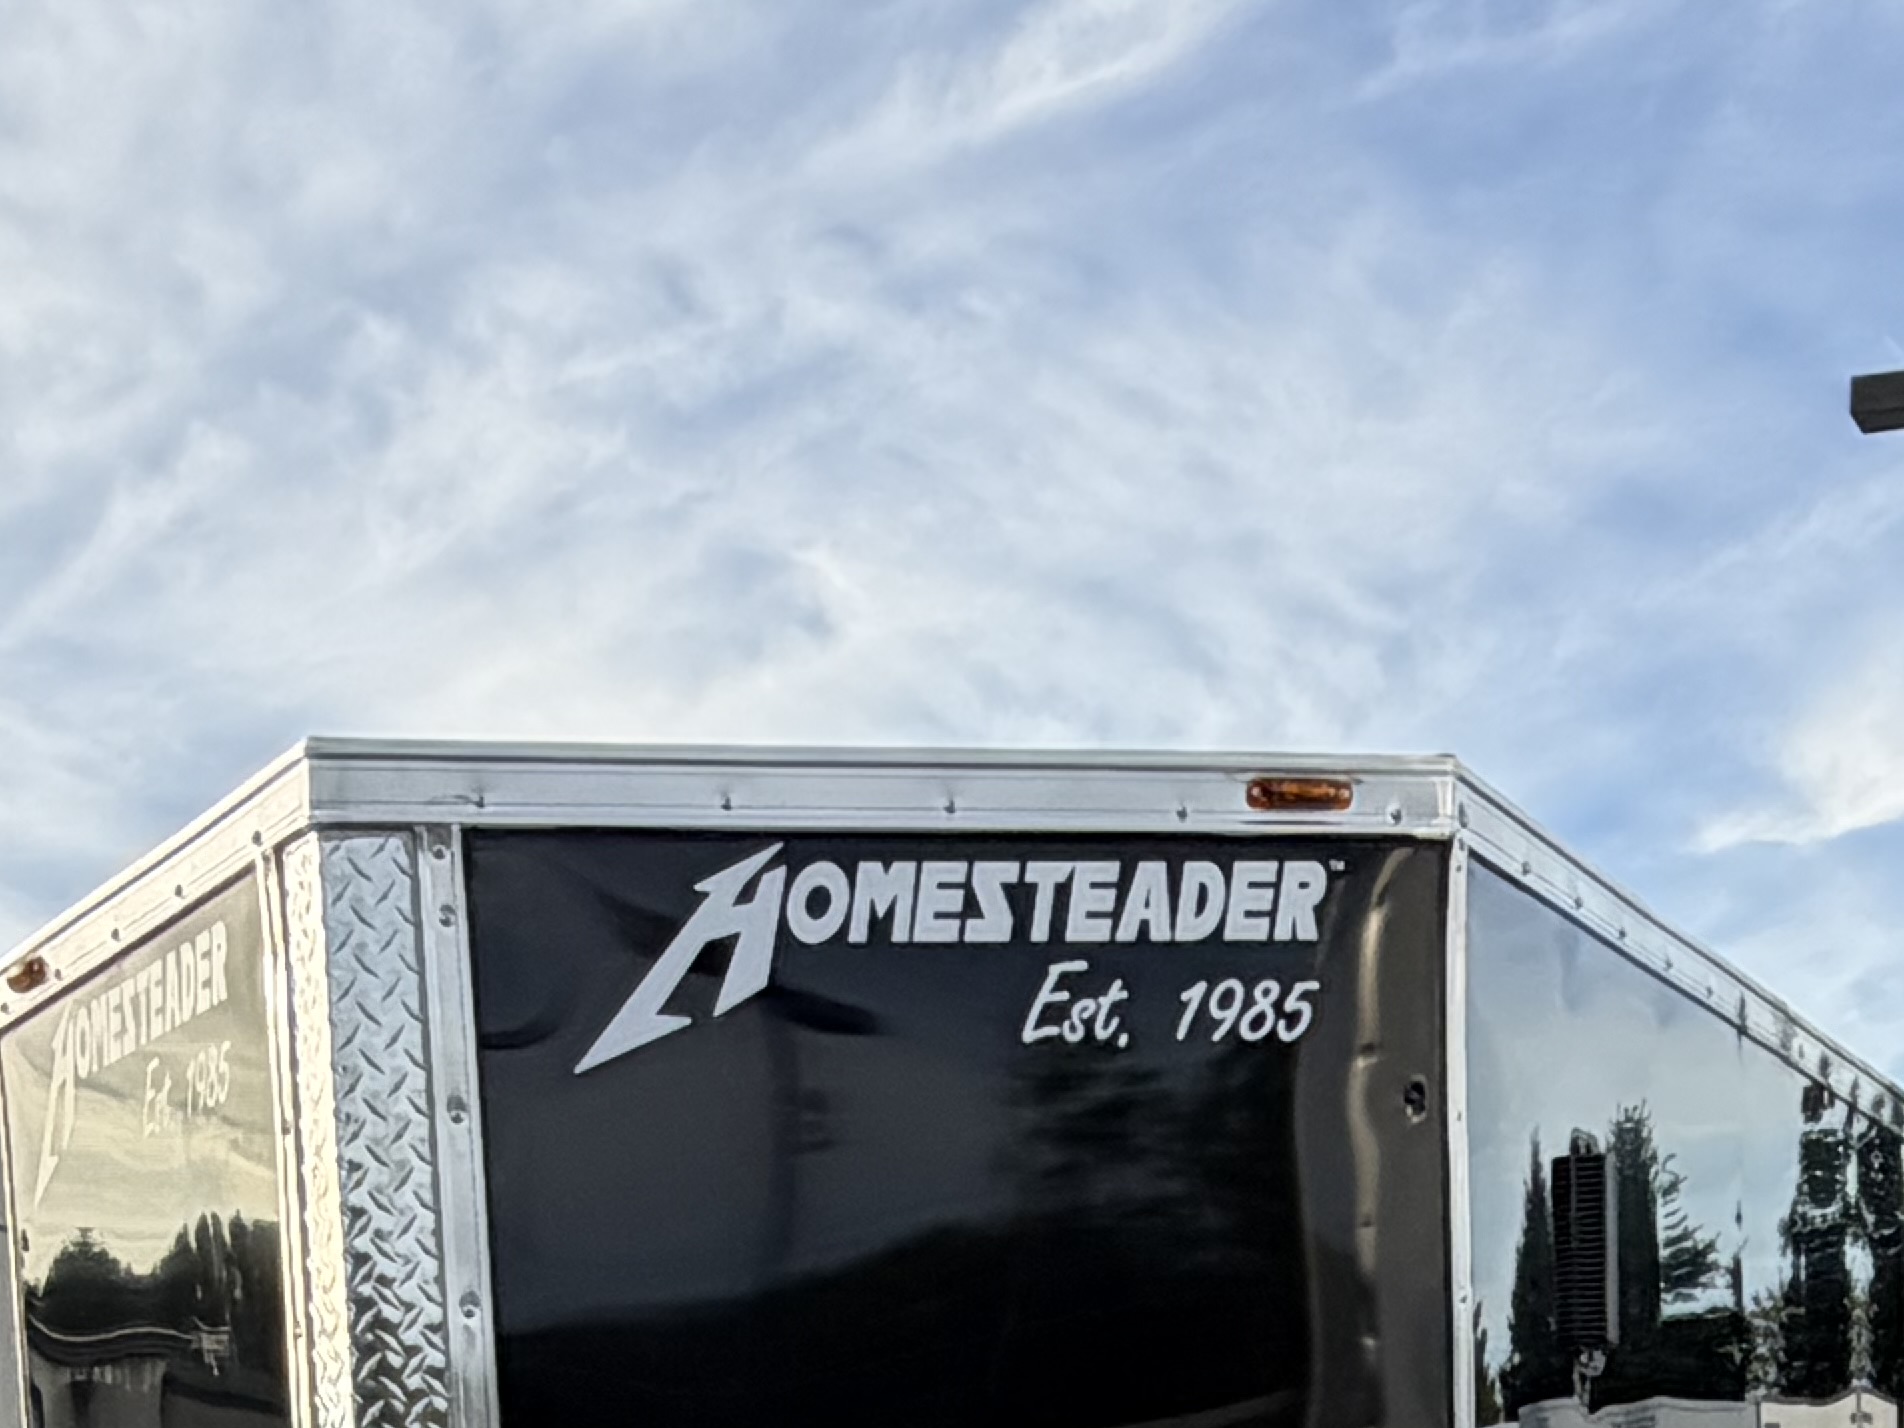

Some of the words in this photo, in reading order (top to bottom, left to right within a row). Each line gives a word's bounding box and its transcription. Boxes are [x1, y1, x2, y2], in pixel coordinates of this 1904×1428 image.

[33, 920, 228, 1213] HOMESTEADER
[575, 842, 1327, 1074] HOMESTEADER
[1021, 959, 1129, 1048] Est.
[1176, 978, 1320, 1042] 1985
